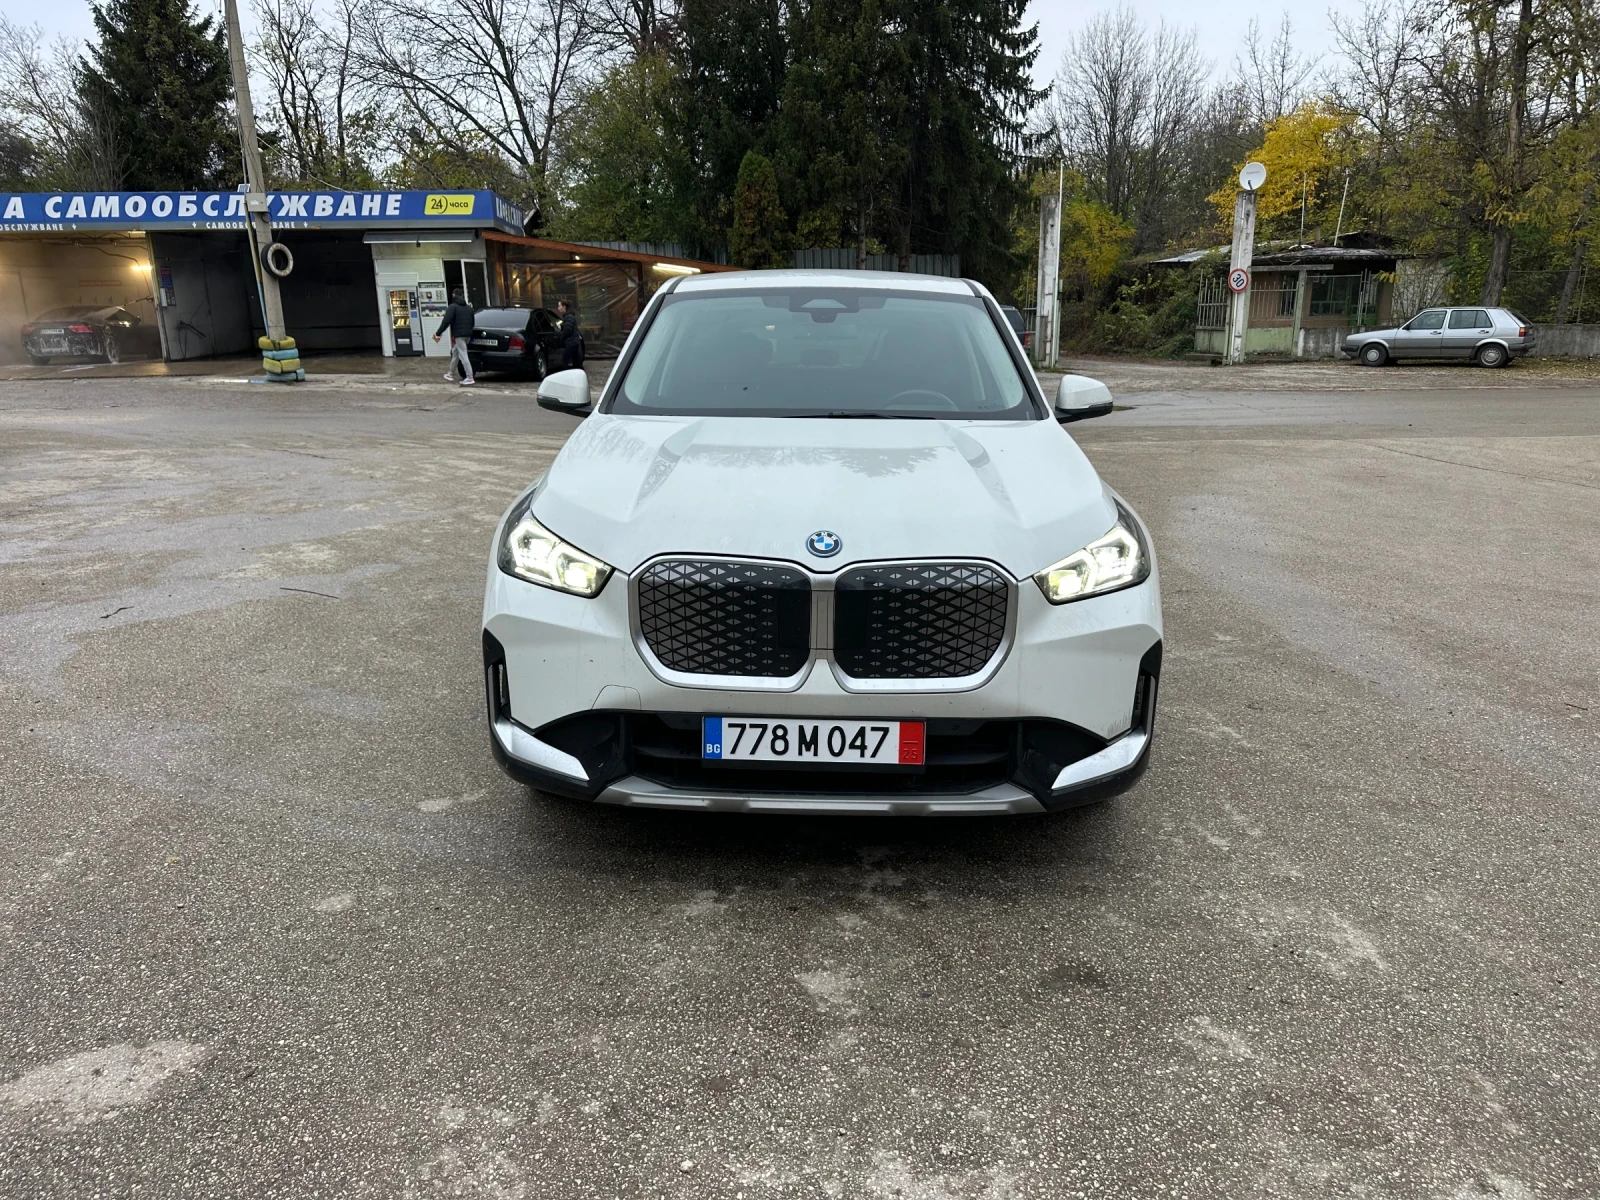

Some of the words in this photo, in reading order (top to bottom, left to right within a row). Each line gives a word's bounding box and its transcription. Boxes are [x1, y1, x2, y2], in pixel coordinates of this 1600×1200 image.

[449, 201, 469, 209] часа
[205, 221, 296, 229] САМООБСЛВАНЕ
[1233, 273, 1245, 287] 30
[706, 743, 721, 754] BG
[727, 723, 790, 756] 778
[798, 724, 819, 757] M
[827, 725, 890, 759] 047
[902, 748, 918, 760] 25
